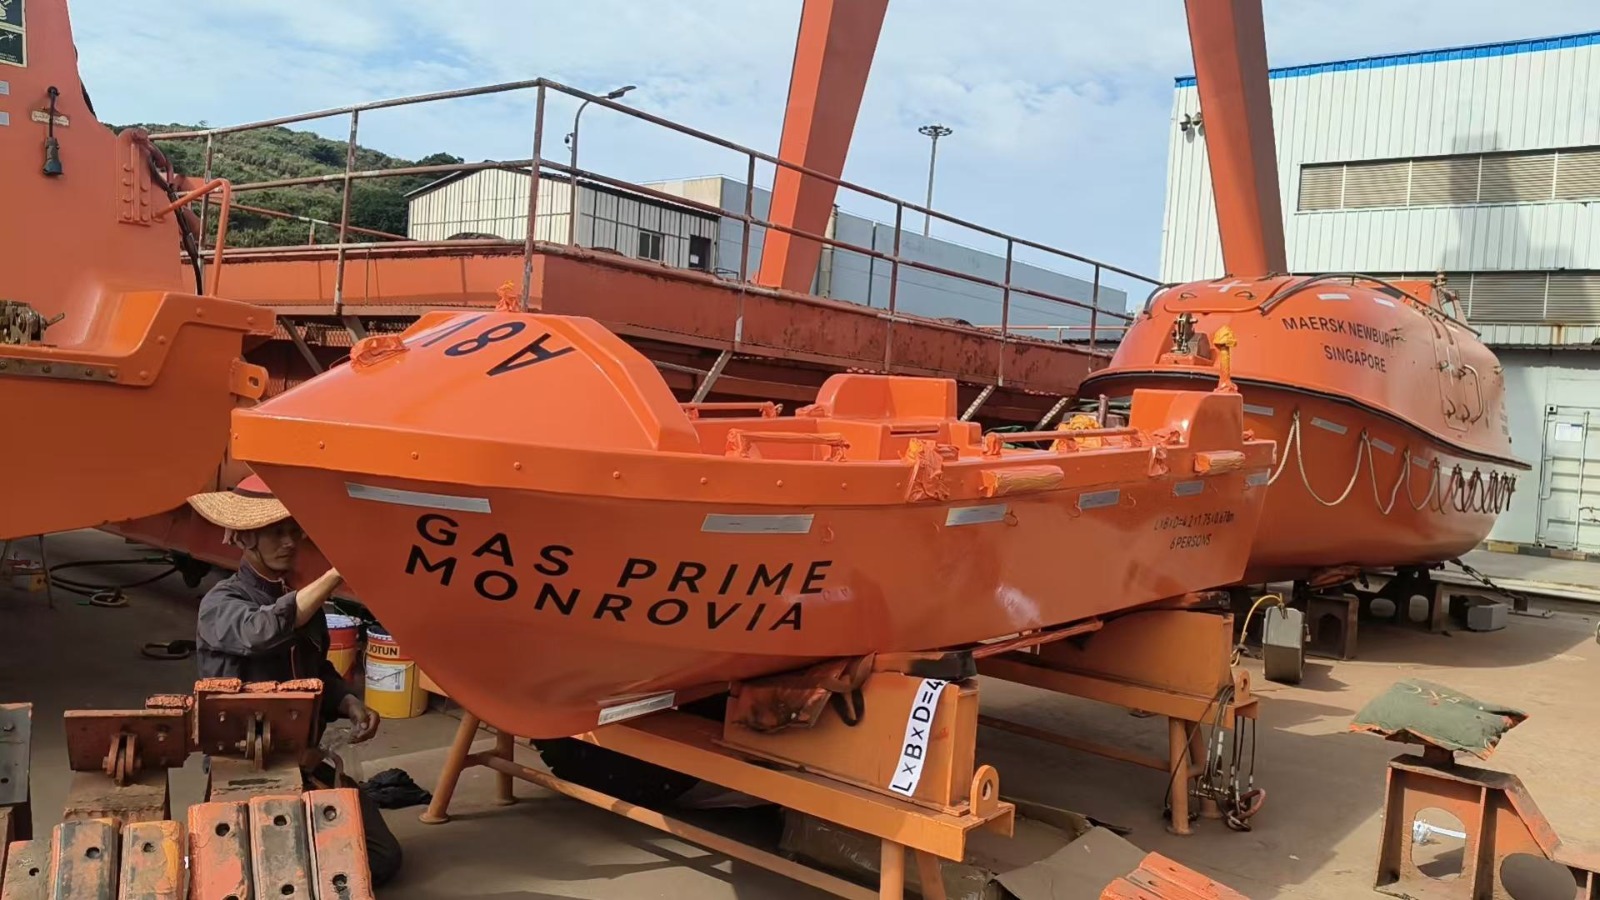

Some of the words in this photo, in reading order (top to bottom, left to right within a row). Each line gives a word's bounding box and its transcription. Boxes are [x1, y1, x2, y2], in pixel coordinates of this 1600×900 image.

[1282, 316, 1347, 335] MAERSK
[1348, 321, 1396, 349] NEWBURY
[1323, 344, 1387, 373] SINGAPORE
[415, 513, 575, 577] GAS
[616, 558, 833, 596] PRIME
[404, 544, 802, 632] MONROVIA
[368, 644, 398, 656] JOTUN
